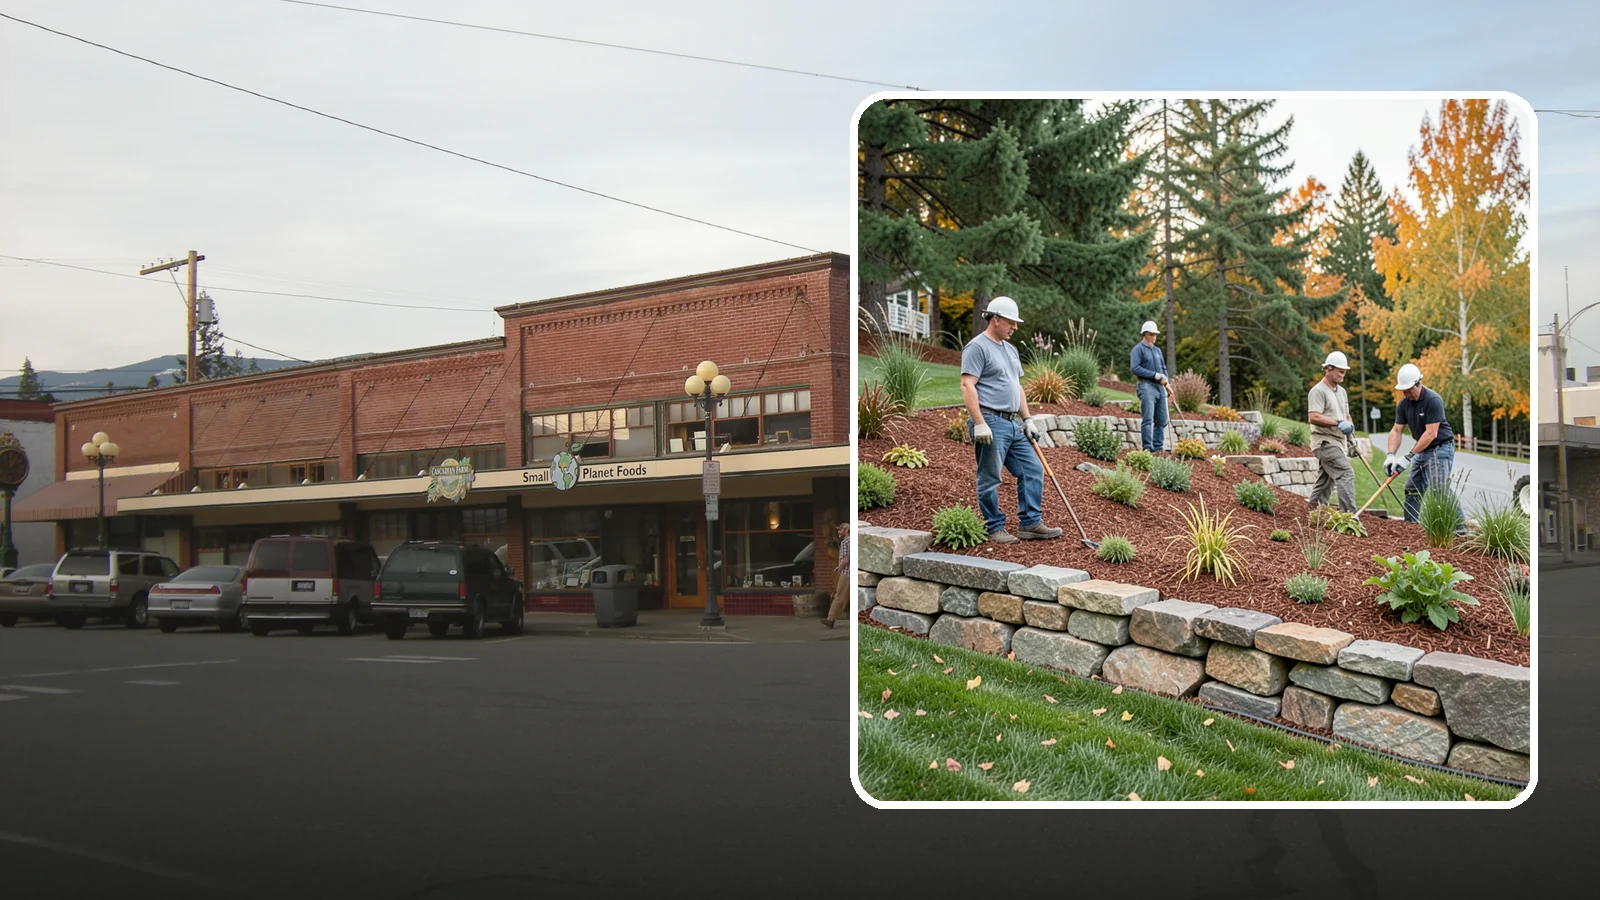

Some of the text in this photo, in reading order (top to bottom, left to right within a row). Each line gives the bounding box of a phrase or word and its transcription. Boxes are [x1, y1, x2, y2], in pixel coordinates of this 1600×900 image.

[523, 464, 647, 483] Small Planet Foods
